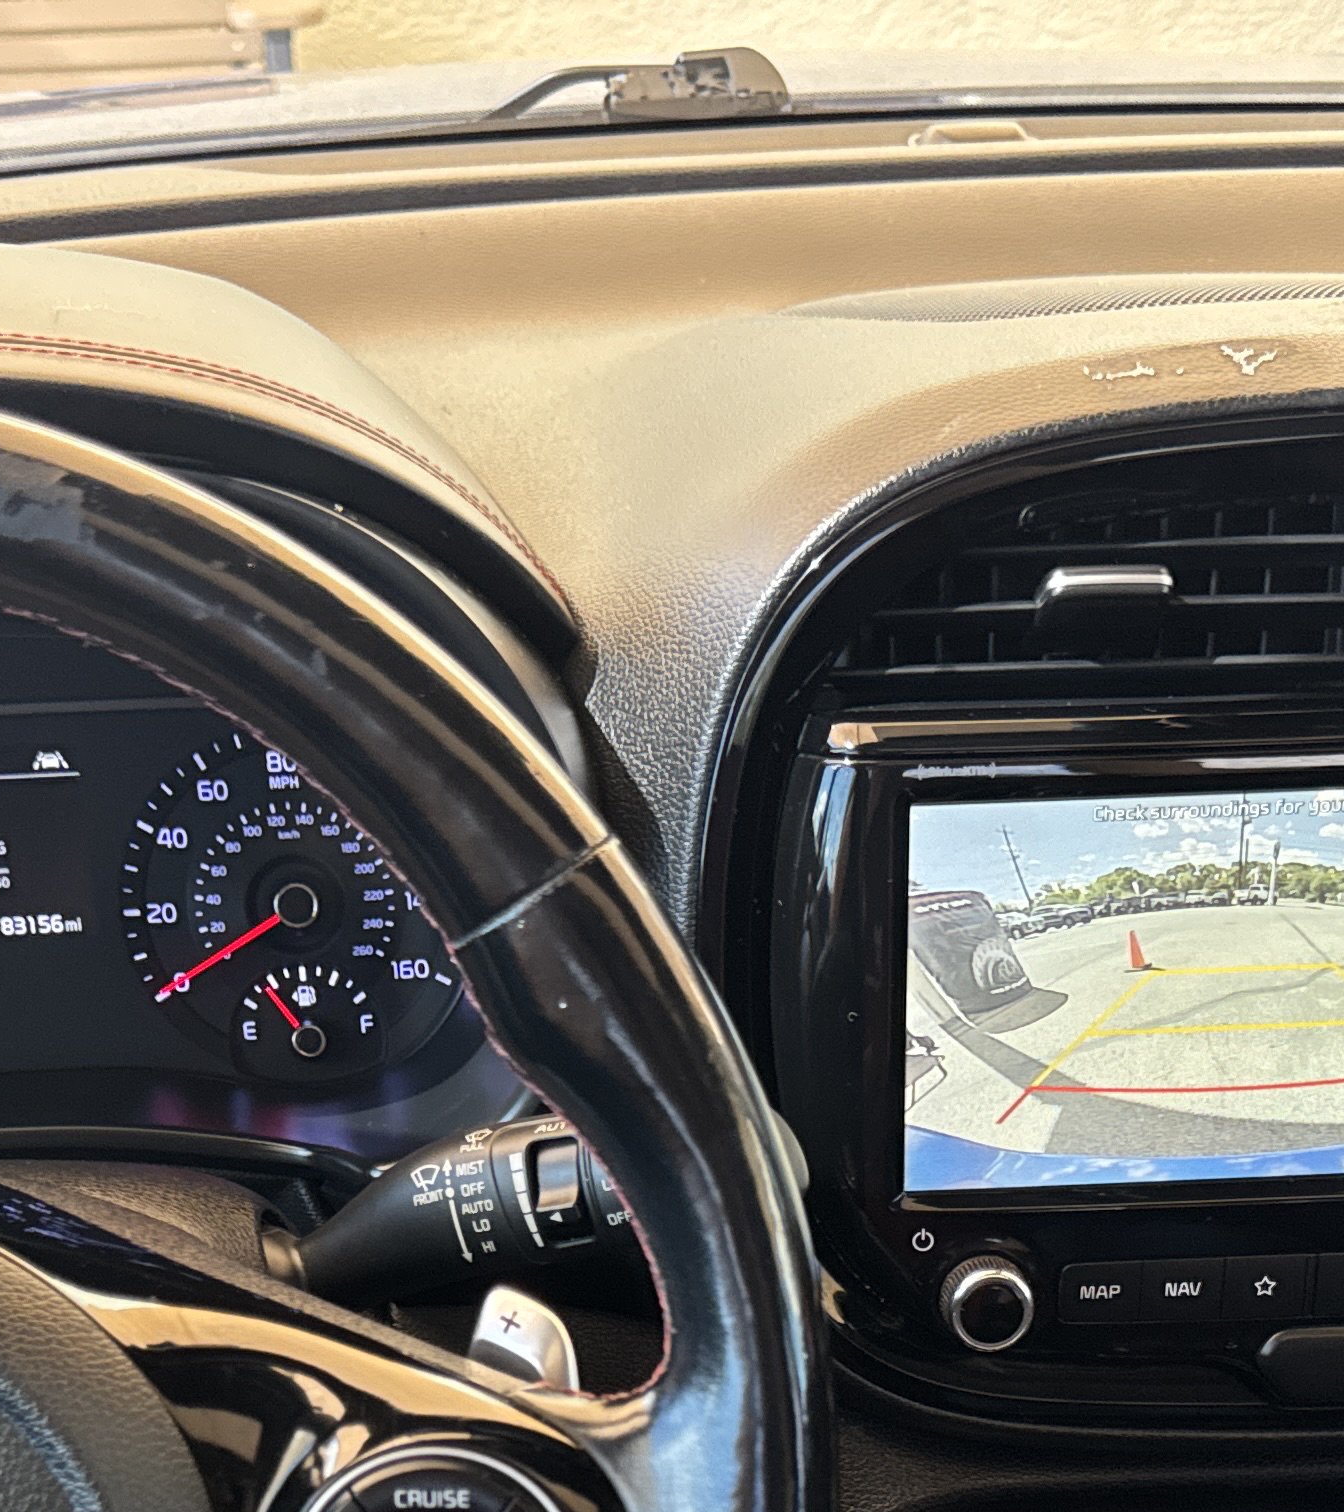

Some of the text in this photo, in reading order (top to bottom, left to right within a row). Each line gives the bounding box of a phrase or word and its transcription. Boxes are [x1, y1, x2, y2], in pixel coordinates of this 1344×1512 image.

[268, 775, 300, 790] MPH
[196, 779, 229, 802] 60
[1093, 804, 1148, 822] Check
[1150, 800, 1269, 820] surroundings
[1275, 801, 1303, 816] for
[266, 815, 286, 827] 120
[295, 814, 314, 826] 140
[156, 827, 188, 849] 40
[242, 825, 262, 837] 100
[278, 829, 300, 840] km/h
[320, 825, 340, 837] 160
[225, 842, 241, 853] 80
[341, 842, 360, 853] 180
[211, 865, 227, 877] 60
[354, 863, 374, 875] 200
[206, 894, 221, 905] 40
[364, 890, 384, 901] 220
[146, 903, 177, 924] 20
[210, 921, 225, 933] 20
[363, 919, 383, 930] 240
[352, 945, 374, 957] 260
[391, 959, 430, 979] 160
[242, 1021, 258, 1041] E
[360, 1014, 374, 1034] F
[456, 1160, 484, 1177] MIST
[460, 1181, 485, 1197] OFF
[413, 1188, 443, 1206] FRONT
[461, 1198, 494, 1215] AUTO
[472, 1218, 491, 1233] LO
[607, 1211, 632, 1226] OFF
[481, 1240, 496, 1253] HI
[1080, 1284, 1121, 1300] MAP
[1165, 1281, 1202, 1297] NAV
[394, 1489, 471, 1509] CRUISE
